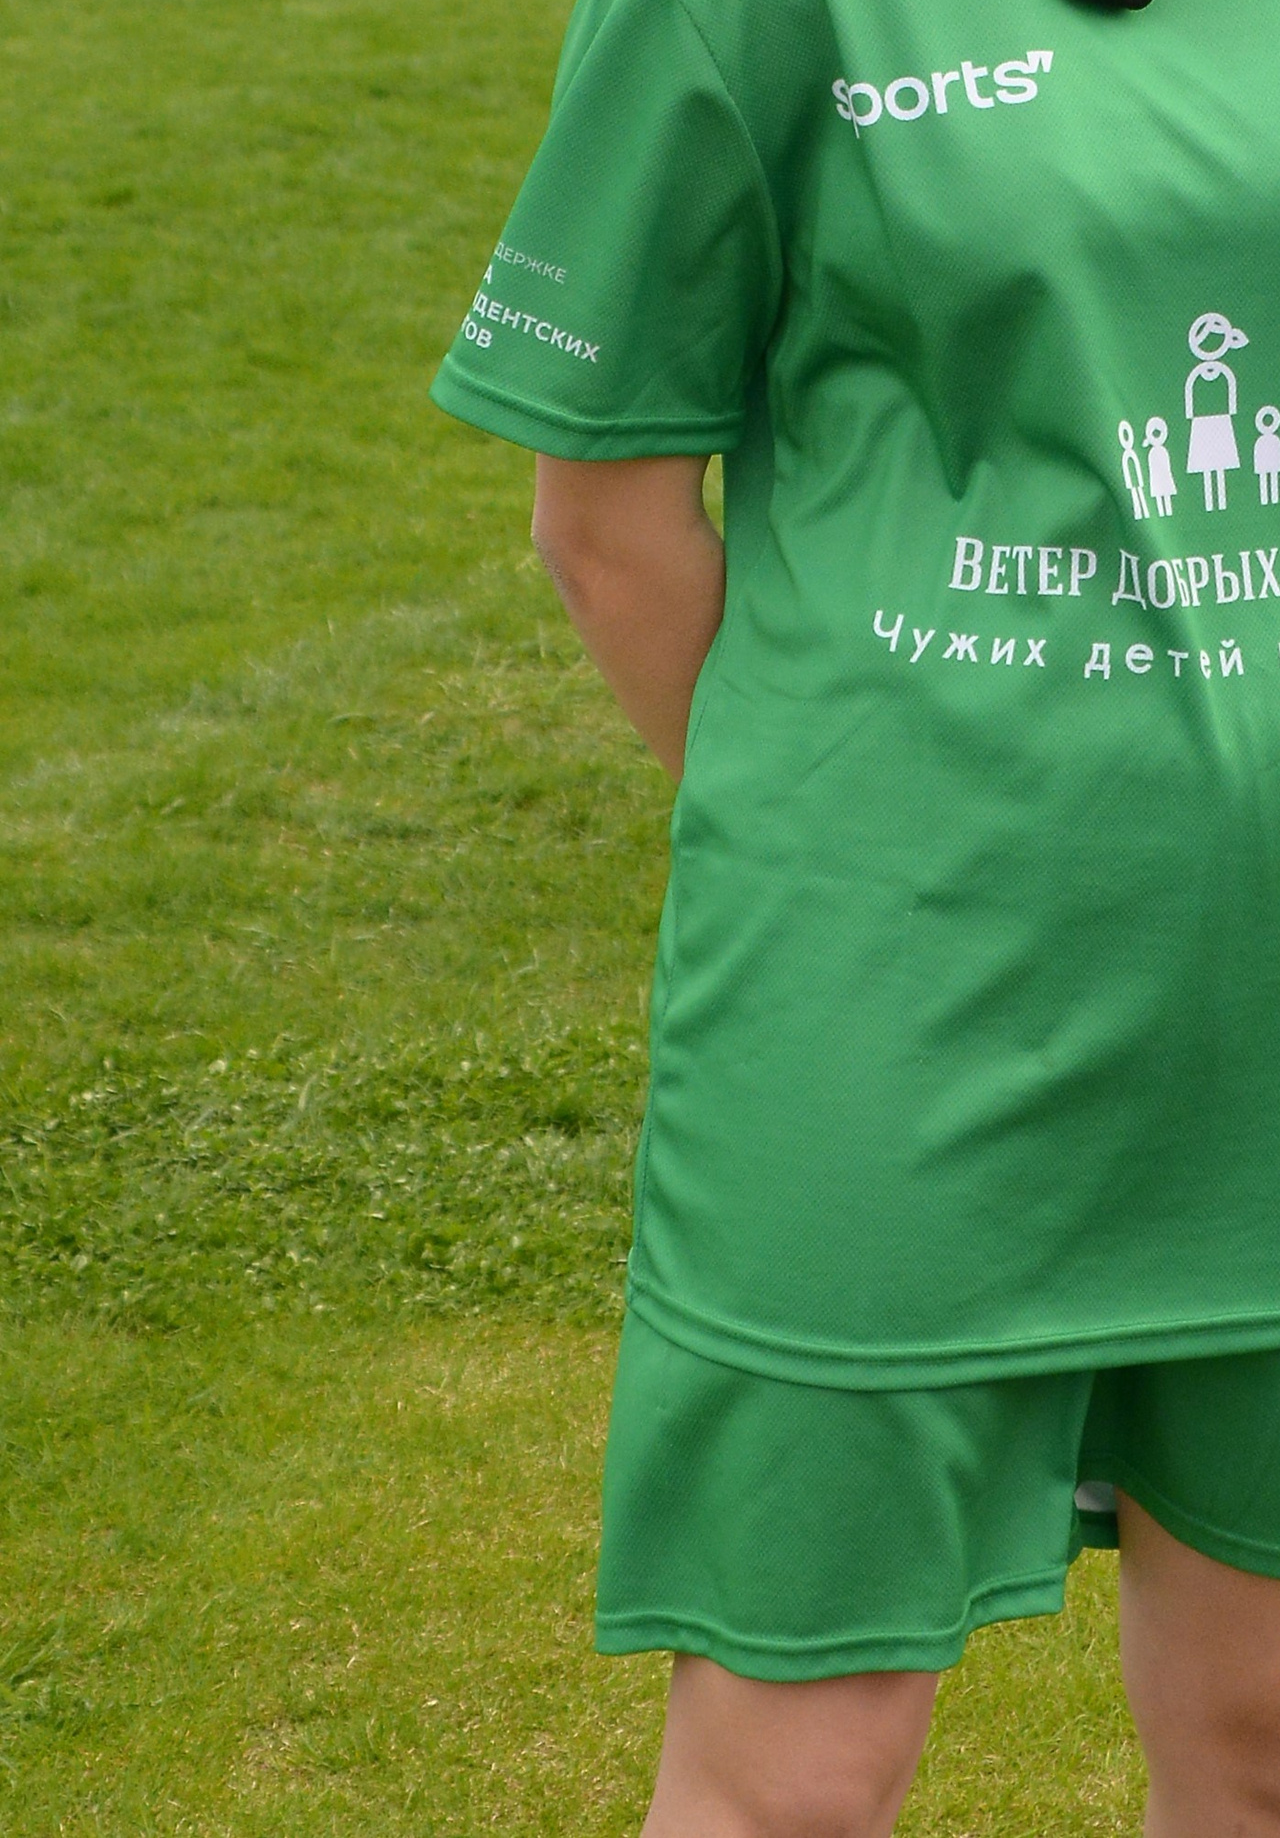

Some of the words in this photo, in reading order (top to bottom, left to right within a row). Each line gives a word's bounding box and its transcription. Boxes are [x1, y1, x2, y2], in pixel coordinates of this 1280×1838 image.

[948, 536, 1098, 596] ВЕТЕР
[873, 610, 1047, 667] Чужих
[1084, 638, 1245, 680] детей
